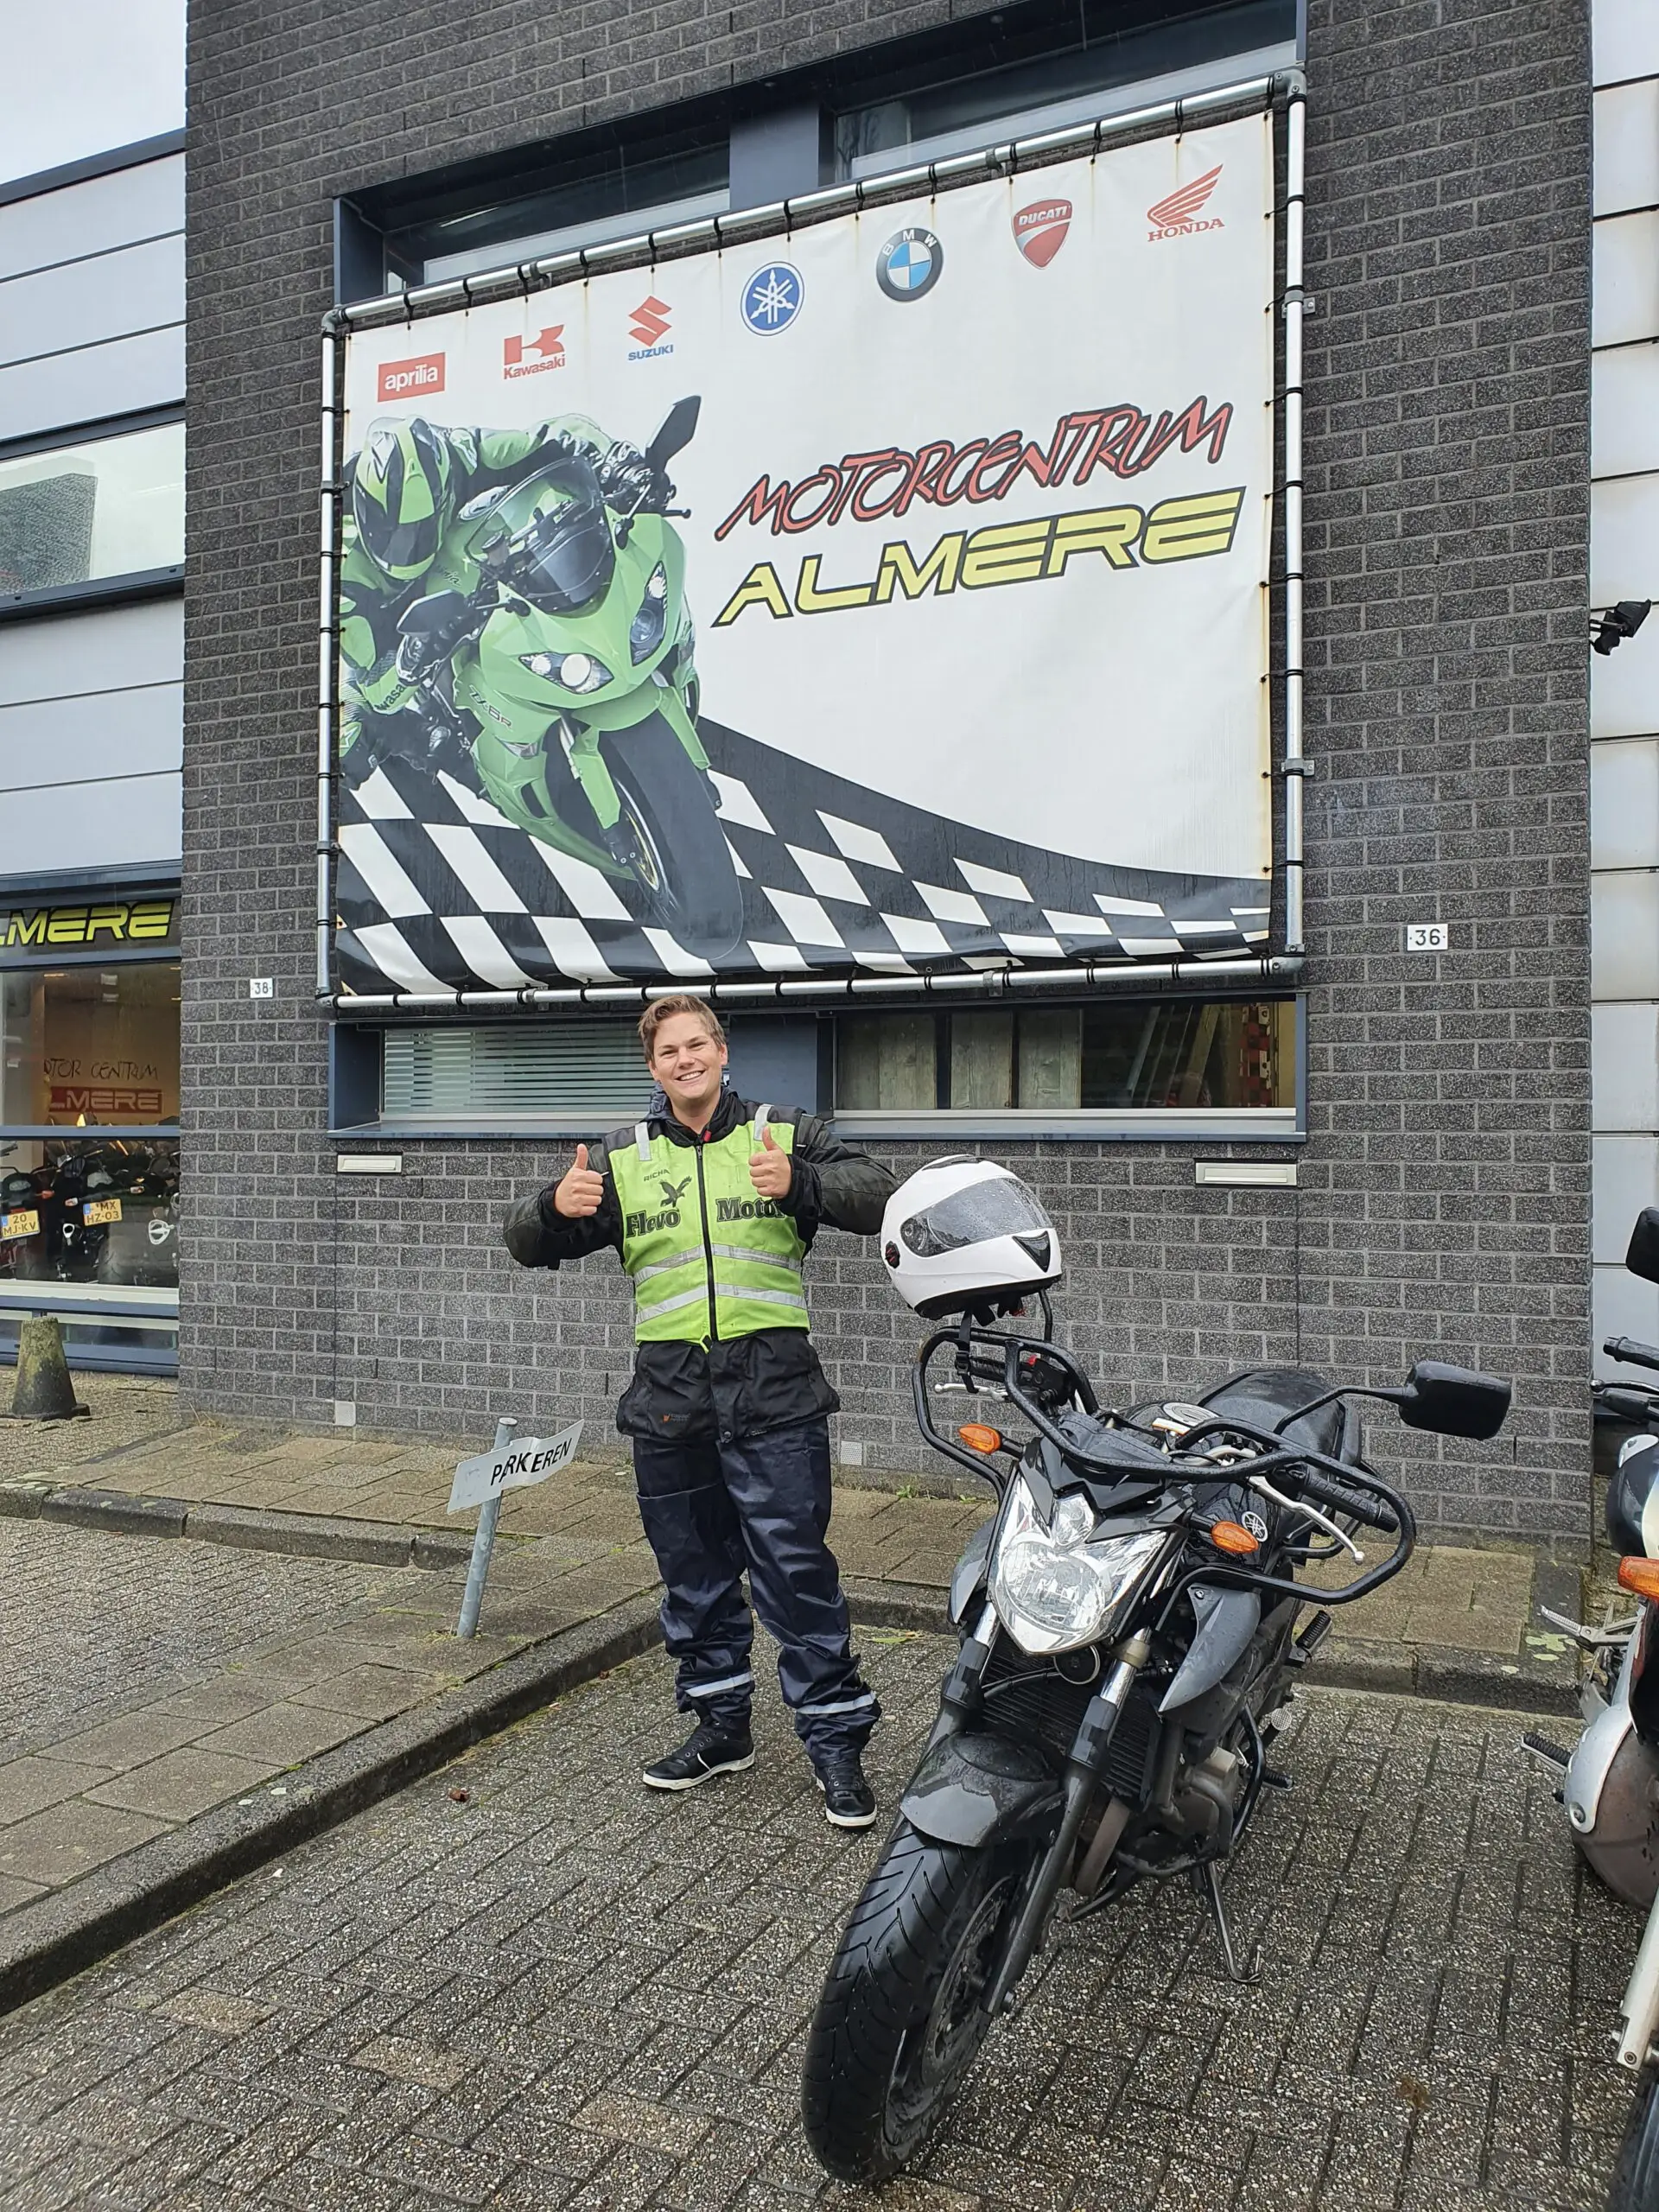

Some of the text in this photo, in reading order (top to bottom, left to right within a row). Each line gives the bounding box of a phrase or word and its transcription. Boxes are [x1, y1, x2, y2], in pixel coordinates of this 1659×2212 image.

[1018, 206, 1068, 226] DUCATI
[1147, 218, 1225, 243] HONDA
[882, 229, 938, 257] BMW
[628, 344, 674, 361] SUZUKI
[385, 363, 438, 392] aprilia
[504, 353, 566, 380] Kawasaki
[715, 396, 1233, 541] MOTORCENTRUM
[710, 486, 1247, 628] ALMERE
[1414, 928, 1441, 946] 36
[254, 982, 269, 995] 38
[91, 1060, 158, 1081] CENTRUM
[643, 1168, 671, 1182] RICHA
[13, 1213, 27, 1224] 20
[625, 1209, 681, 1239] Flevo
